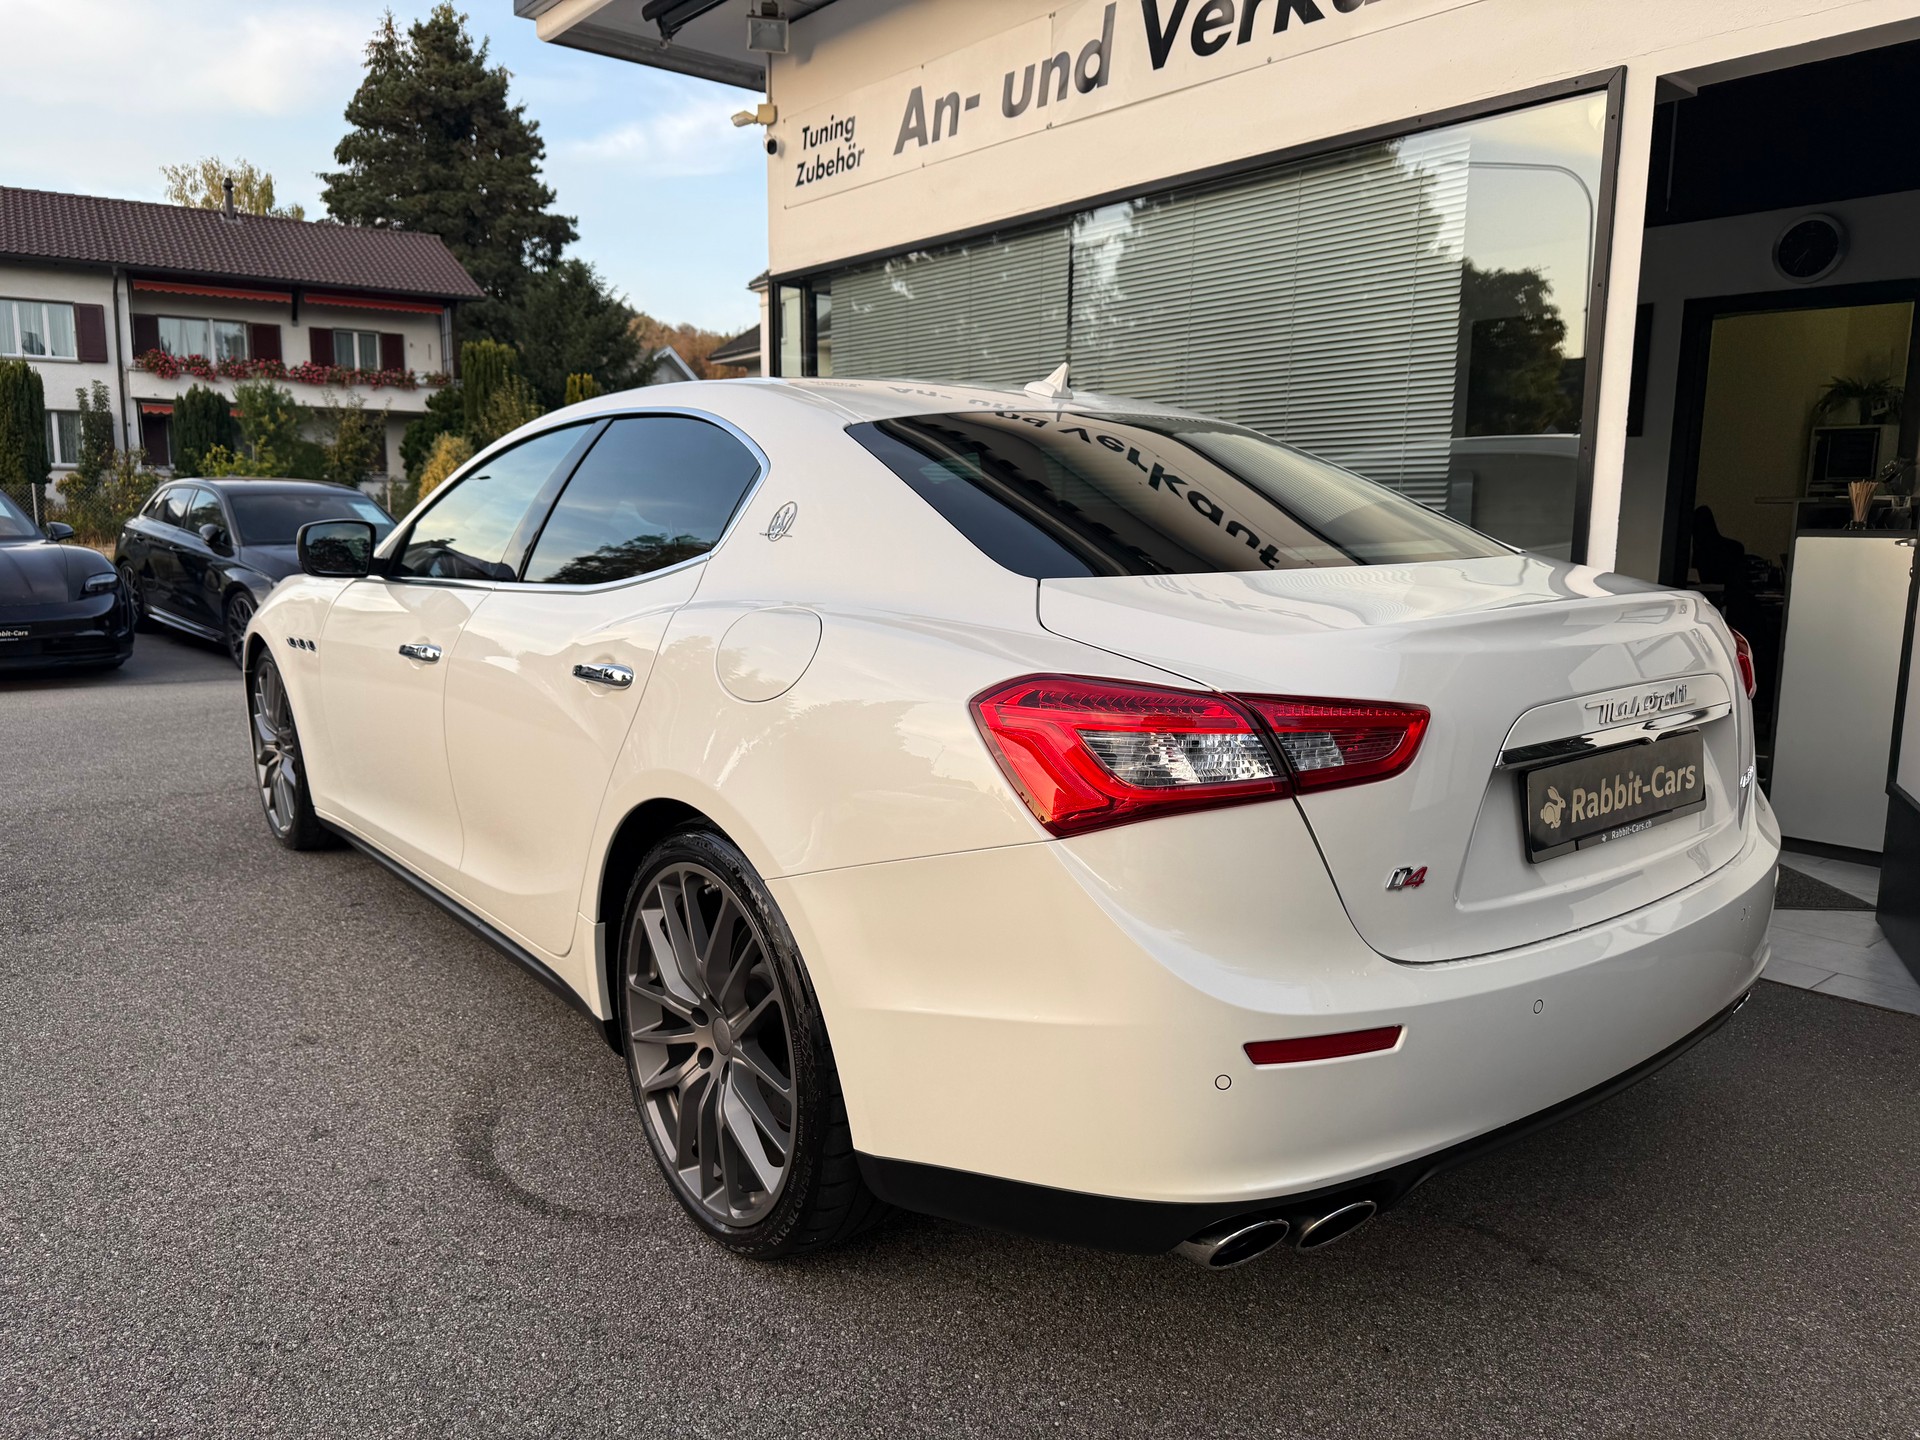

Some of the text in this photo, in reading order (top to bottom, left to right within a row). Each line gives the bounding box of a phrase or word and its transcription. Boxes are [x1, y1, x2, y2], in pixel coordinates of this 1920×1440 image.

[893, 0, 1381, 156] An- und Ver
[802, 114, 856, 150] Tuning
[795, 143, 865, 187] Zubehör
[1571, 763, 1696, 823] Rabbit-Cars
[1611, 819, 1653, 840] Rabbit-Cars.ch
